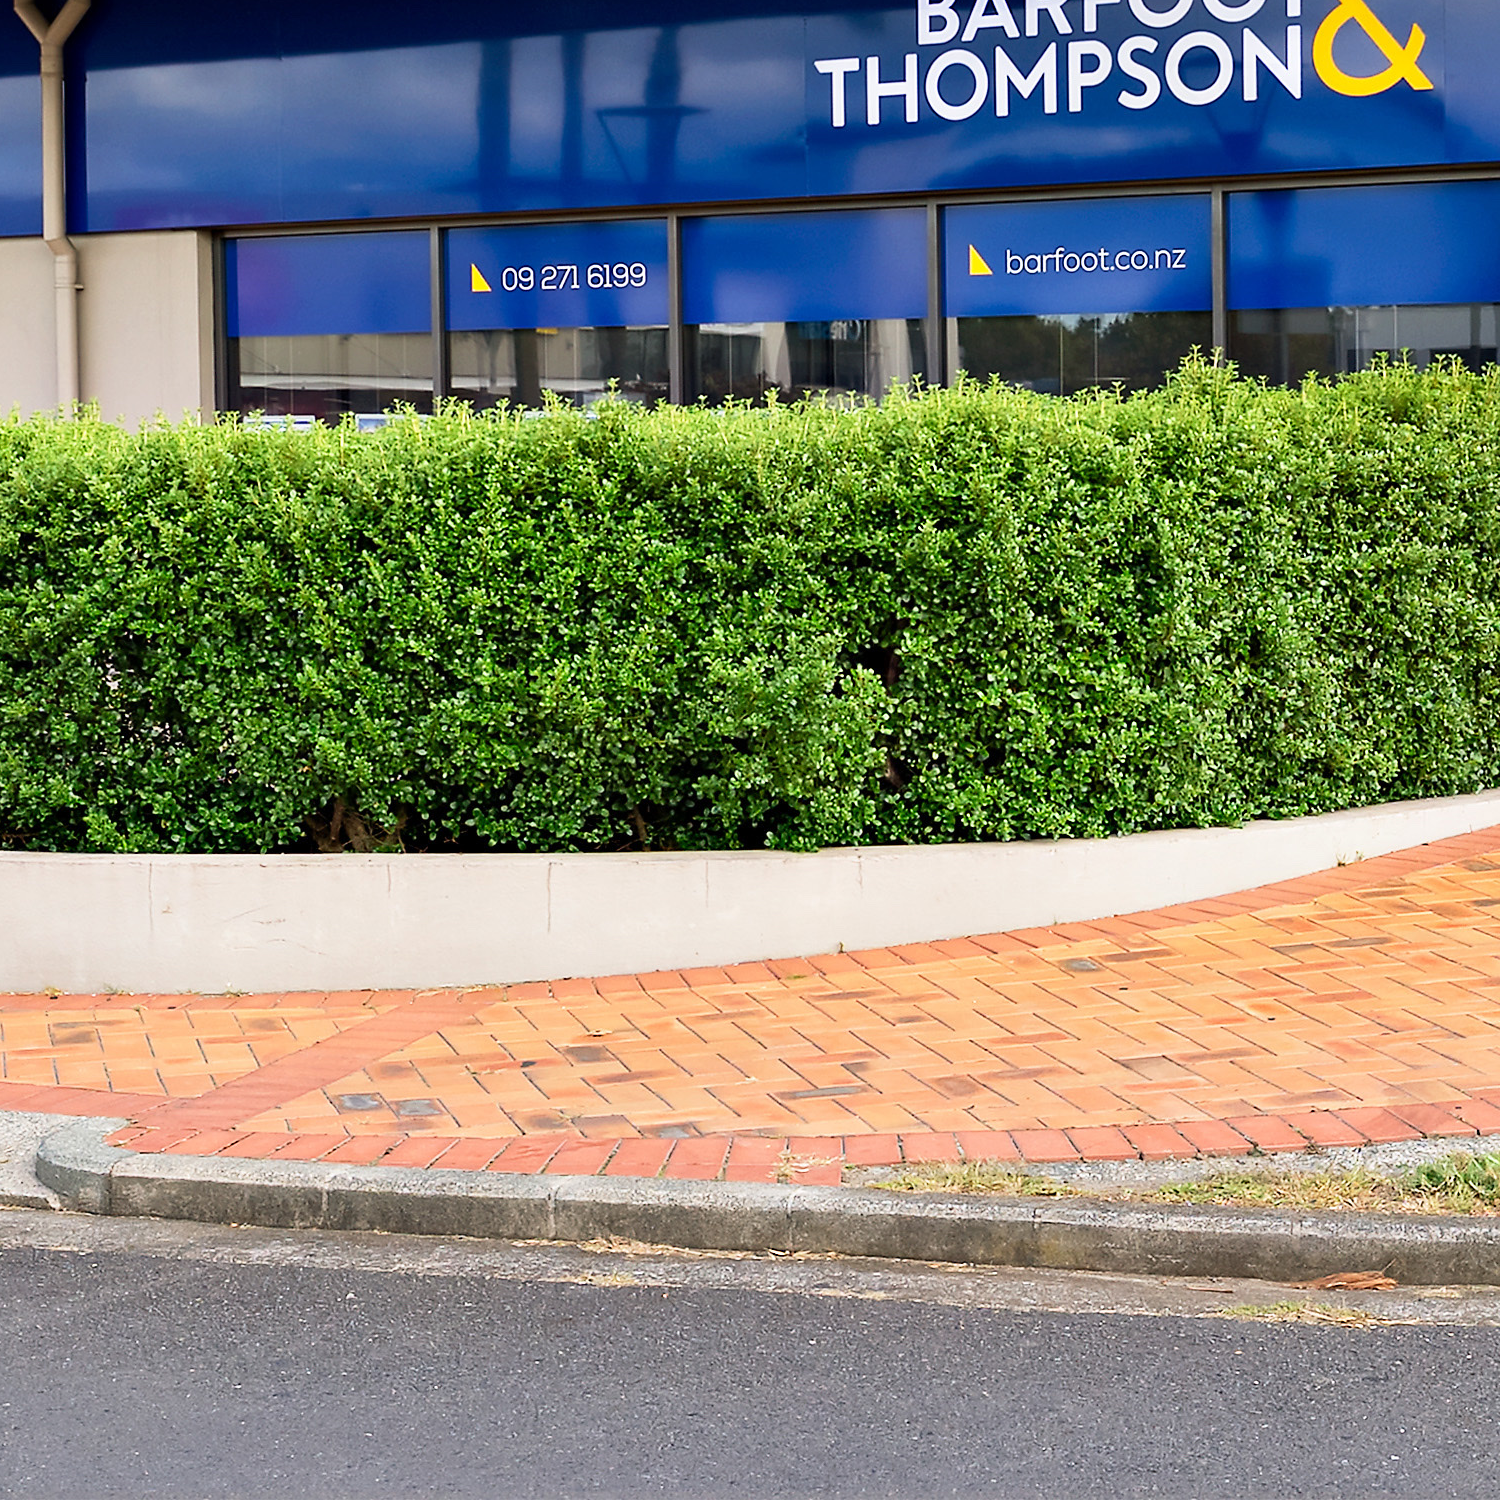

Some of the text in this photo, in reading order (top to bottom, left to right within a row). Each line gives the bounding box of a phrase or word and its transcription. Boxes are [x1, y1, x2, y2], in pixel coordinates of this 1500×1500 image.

[813, 24, 1302, 128] THOMPSON
[1006, 246, 1186, 274] barfoot.co.nz
[502, 262, 647, 291] 09 271 6199
